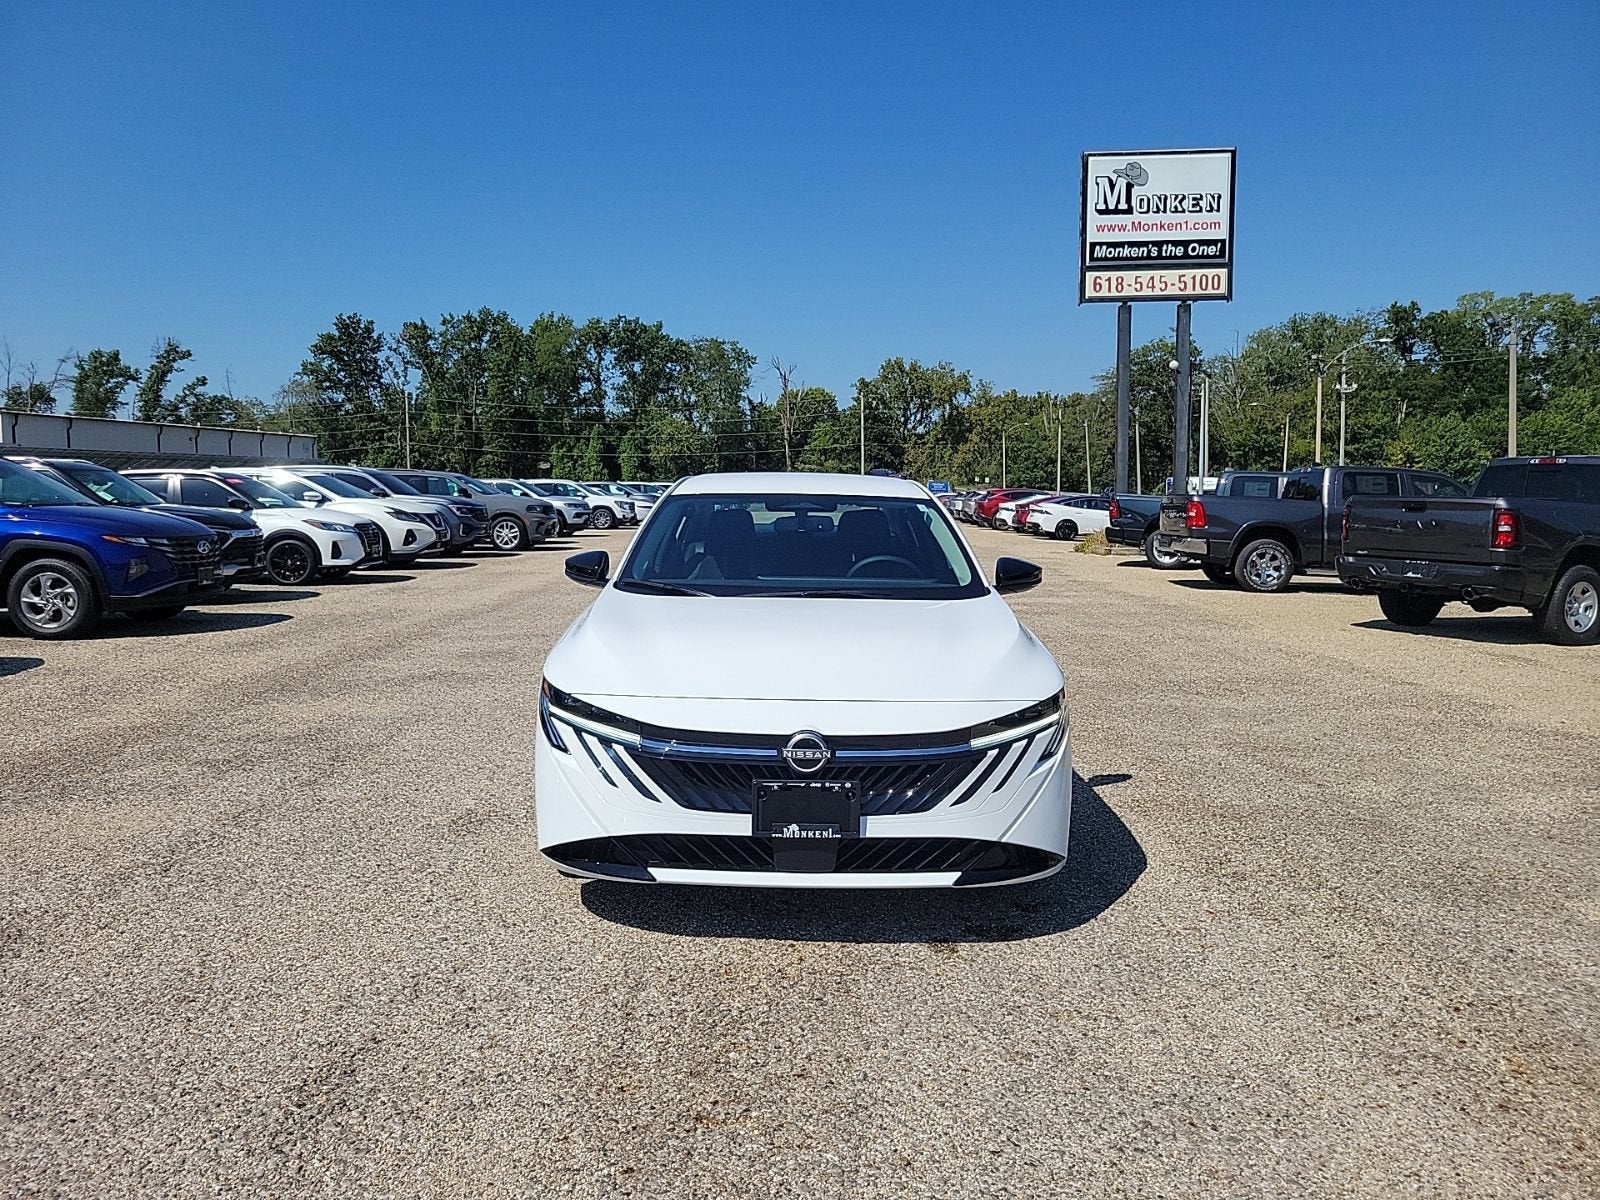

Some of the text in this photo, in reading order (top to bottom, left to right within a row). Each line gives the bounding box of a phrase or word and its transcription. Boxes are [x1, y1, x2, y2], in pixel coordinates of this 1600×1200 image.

[1095, 176, 1222, 215] MONKEN
[1095, 220, 1221, 233] www.Monken1.com
[1094, 242, 1222, 258] Monken's the One!
[1092, 273, 1222, 293] 618-545-5100
[783, 750, 831, 758] NISSAN
